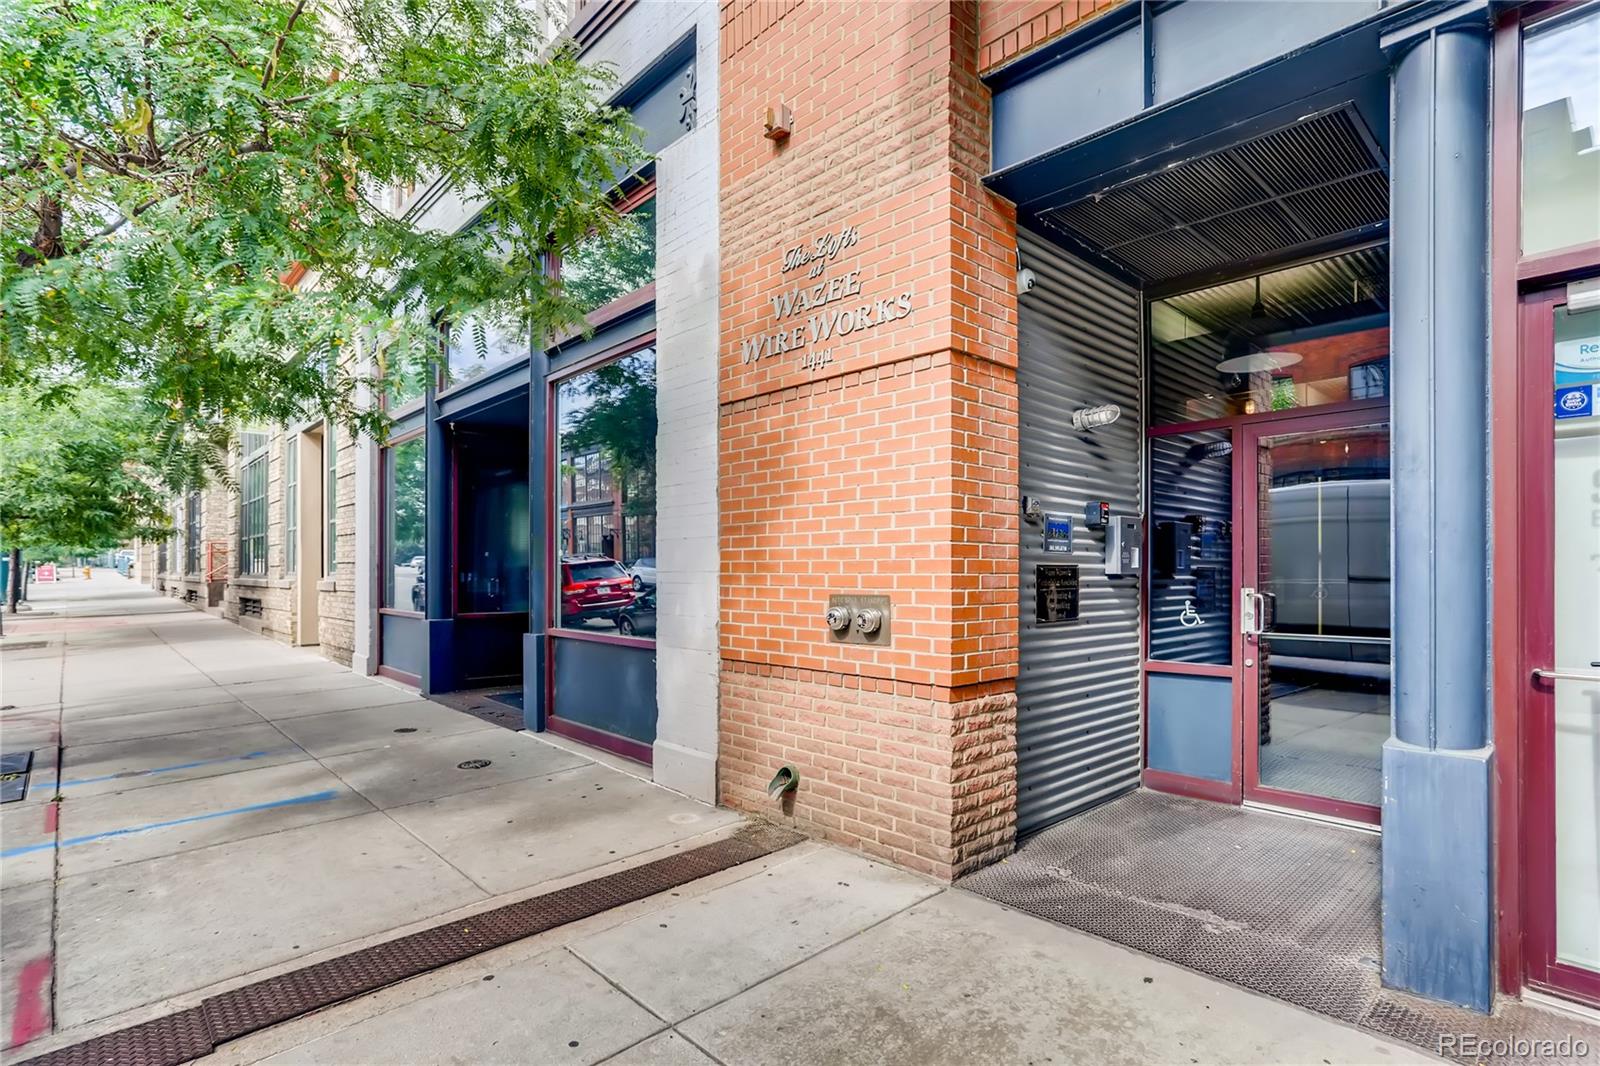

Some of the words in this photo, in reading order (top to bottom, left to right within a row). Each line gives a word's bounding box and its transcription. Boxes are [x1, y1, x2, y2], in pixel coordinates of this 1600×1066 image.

[782, 244, 812, 274] The
[812, 226, 858, 261] Lofts
[808, 259, 825, 280] at
[771, 271, 862, 321] WAZEE
[740, 326, 806, 364] WIRE
[808, 290, 913, 344] WORKS
[801, 348, 833, 371] 1441
